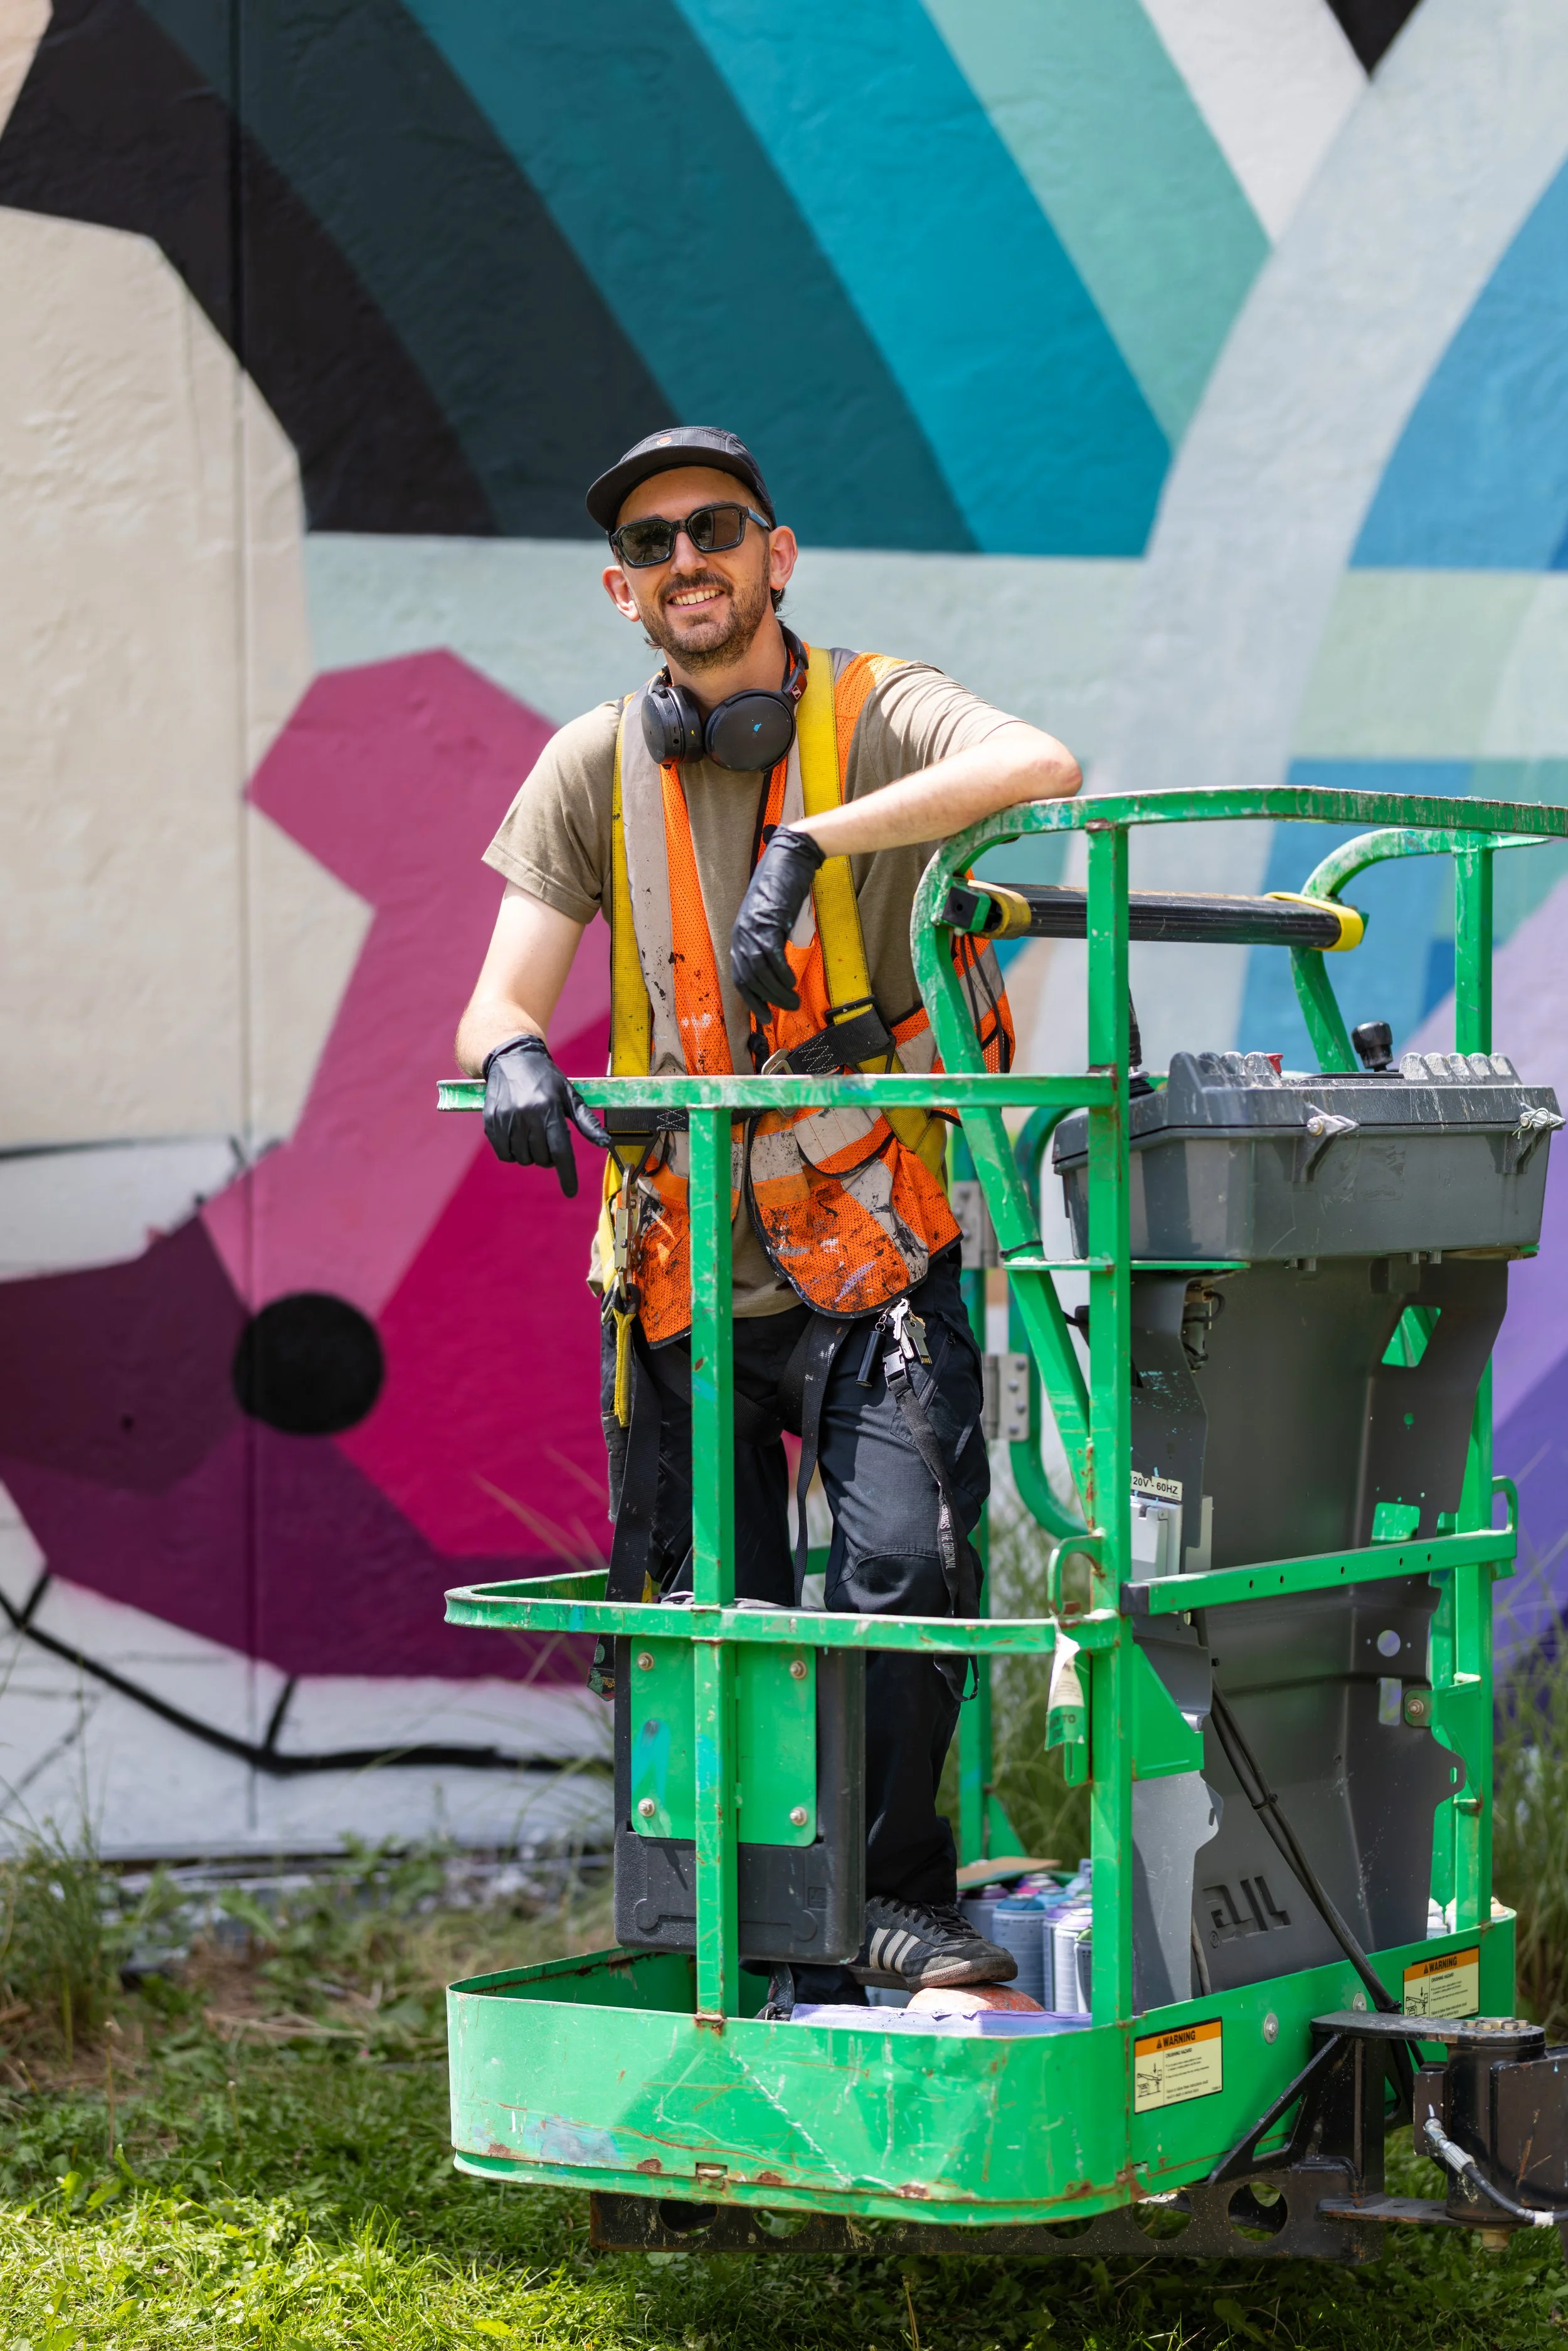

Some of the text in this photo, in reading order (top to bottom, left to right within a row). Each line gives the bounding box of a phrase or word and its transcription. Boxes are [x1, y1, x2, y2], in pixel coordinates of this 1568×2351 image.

[1157, 1482, 1178, 1495] 60HZ
[941, 1531, 953, 1542] THE
[942, 1542, 956, 1569] ORIGINAL
[1429, 1956, 1457, 1972] WARNING
[1163, 2030, 1195, 2047] WARNING
